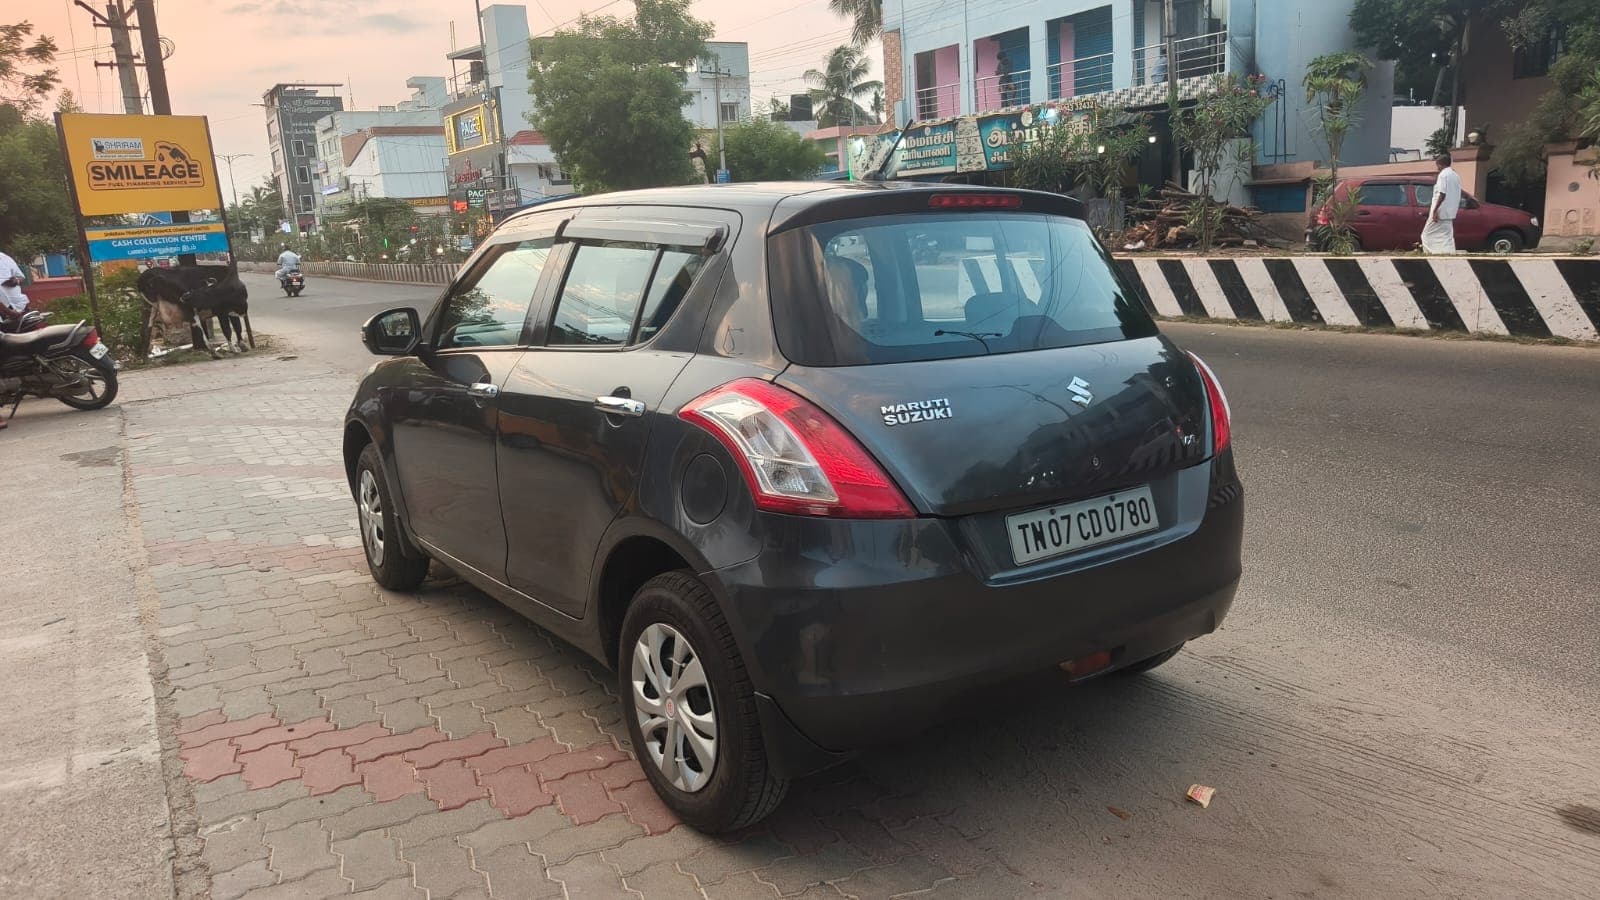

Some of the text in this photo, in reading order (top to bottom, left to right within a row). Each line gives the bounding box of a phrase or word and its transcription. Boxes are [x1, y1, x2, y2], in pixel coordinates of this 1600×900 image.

[104, 140, 142, 149] SHRIRAM
[91, 163, 200, 180] SMILEAGE
[111, 234, 207, 247] CASH COLLECTION CENTRE
[880, 398, 950, 414] MARUTI
[884, 407, 953, 426] SUZUKI
[1018, 497, 1151, 554] TN07CD0780
